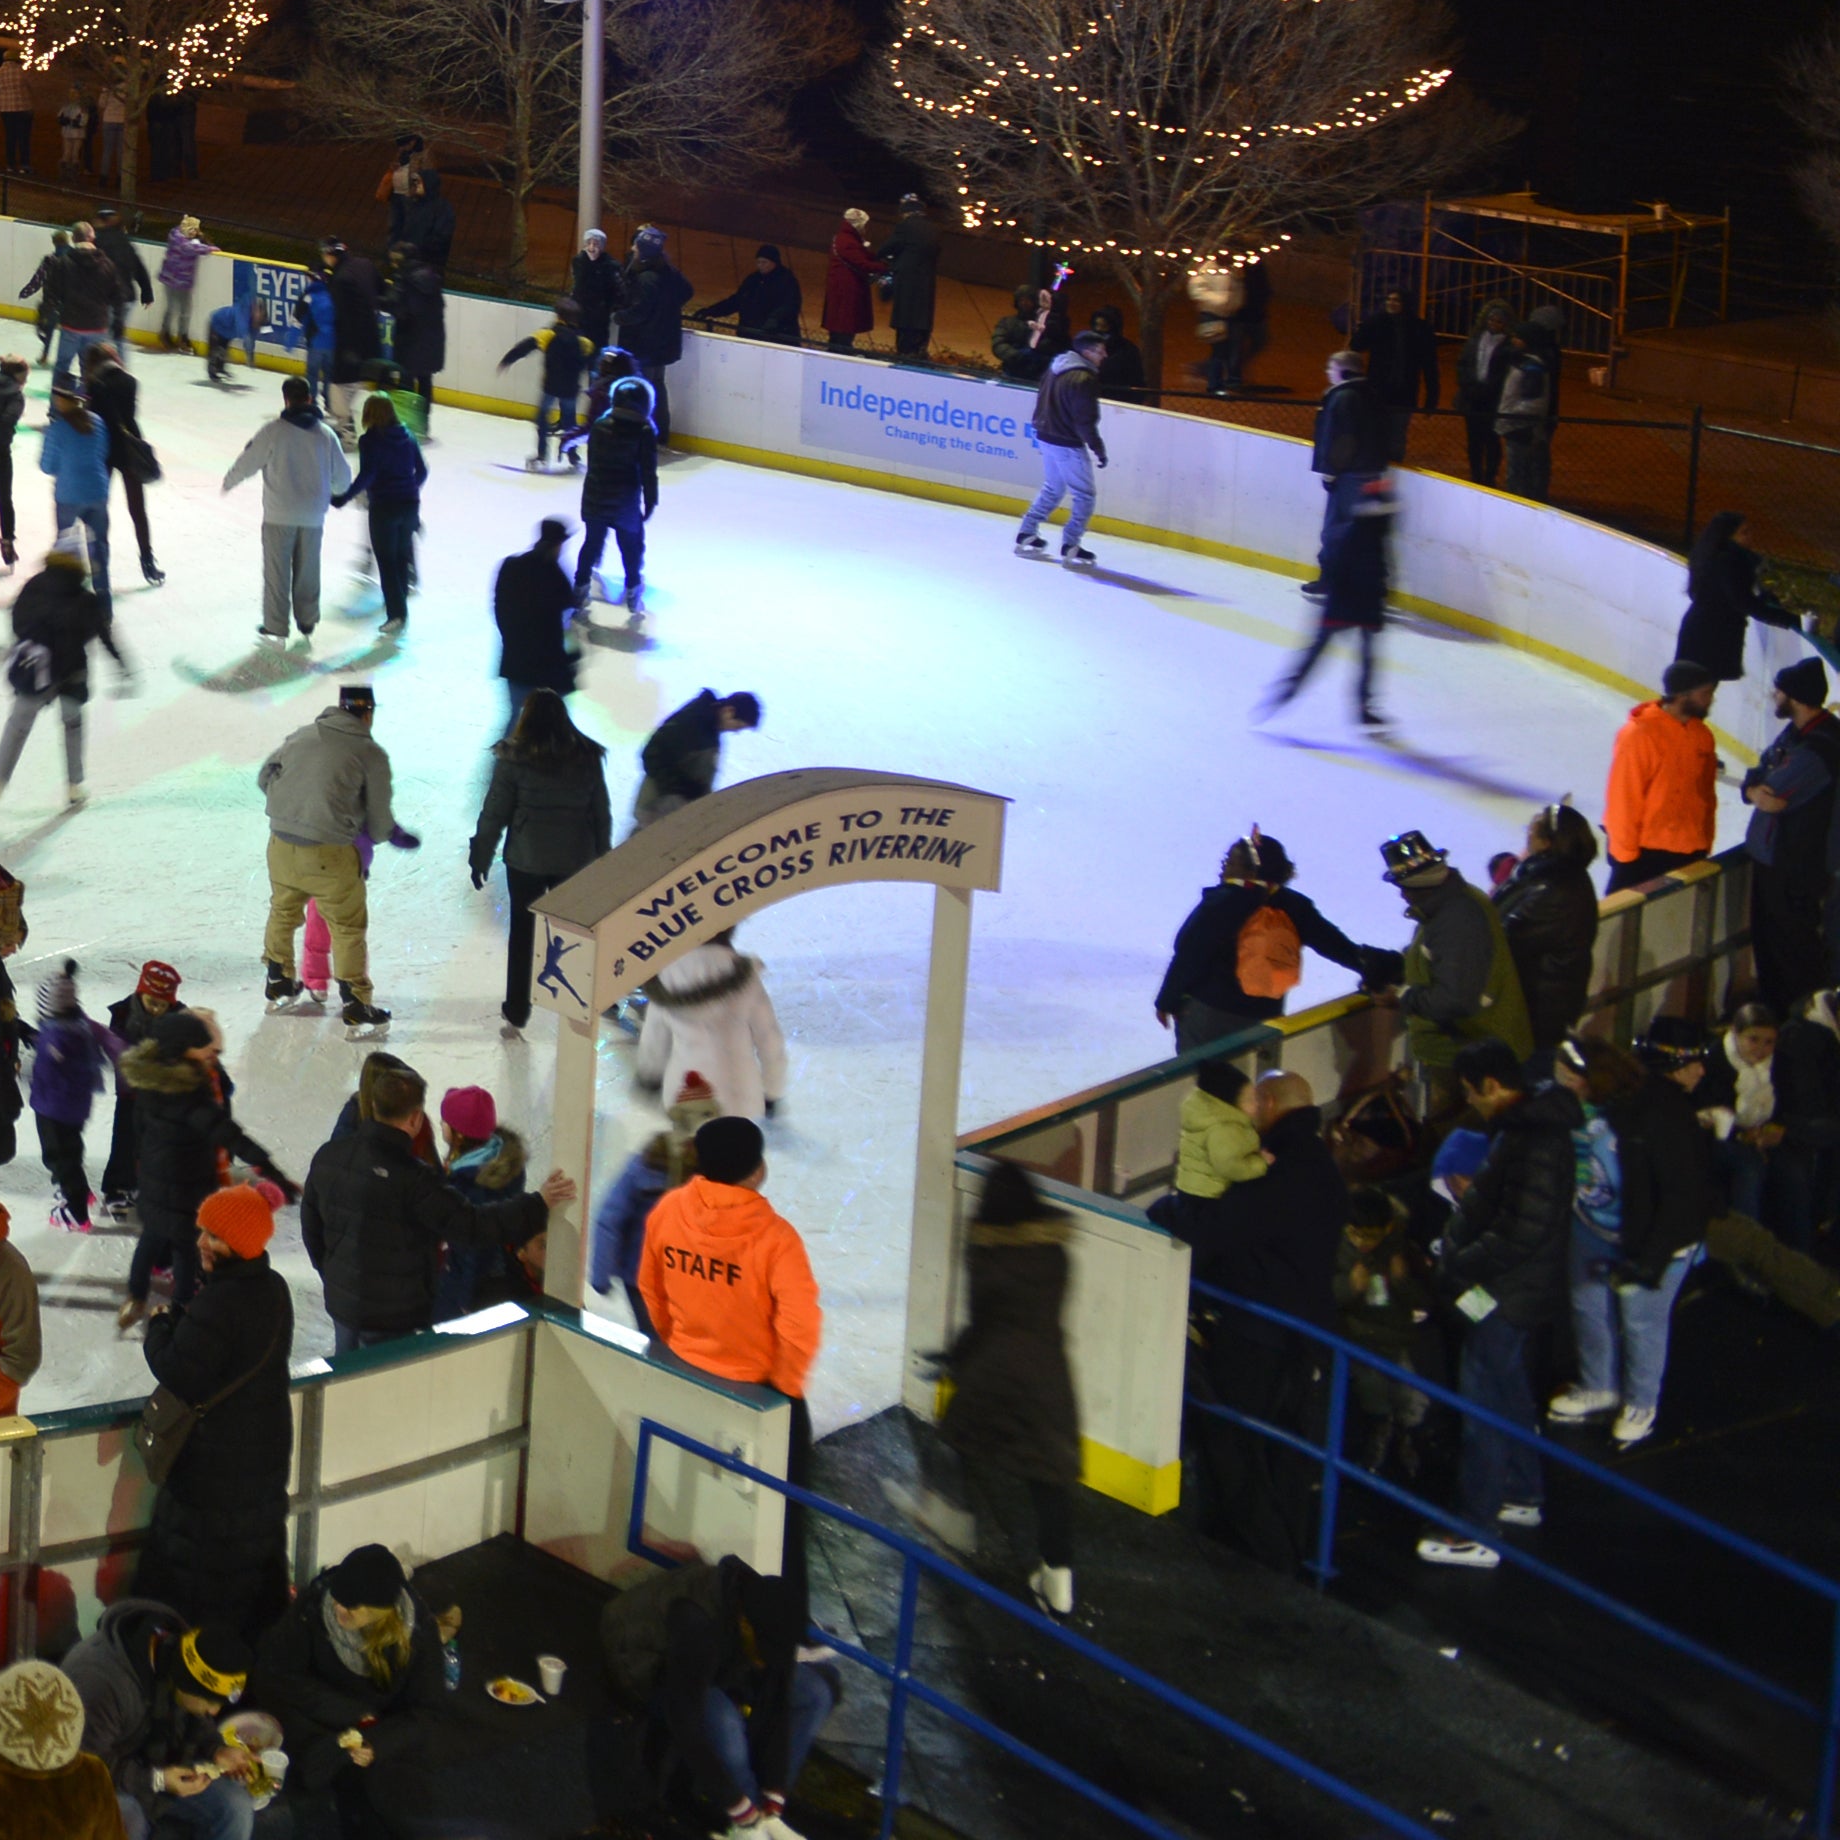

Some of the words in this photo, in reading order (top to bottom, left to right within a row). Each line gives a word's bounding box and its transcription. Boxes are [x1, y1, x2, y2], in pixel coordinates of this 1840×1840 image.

[820, 381, 1017, 439] Independence
[884, 425, 947, 450] Changing
[950, 437, 972, 451] the
[975, 441, 1019, 460] Game.
[636, 822, 821, 917] WELCOME
[839, 810, 883, 832] TO
[900, 808, 956, 827] THE
[627, 902, 704, 961] BLUE
[713, 850, 814, 907] CROSS
[828, 834, 976, 868] RIVERRINK
[664, 1246, 742, 1287] STAFF
